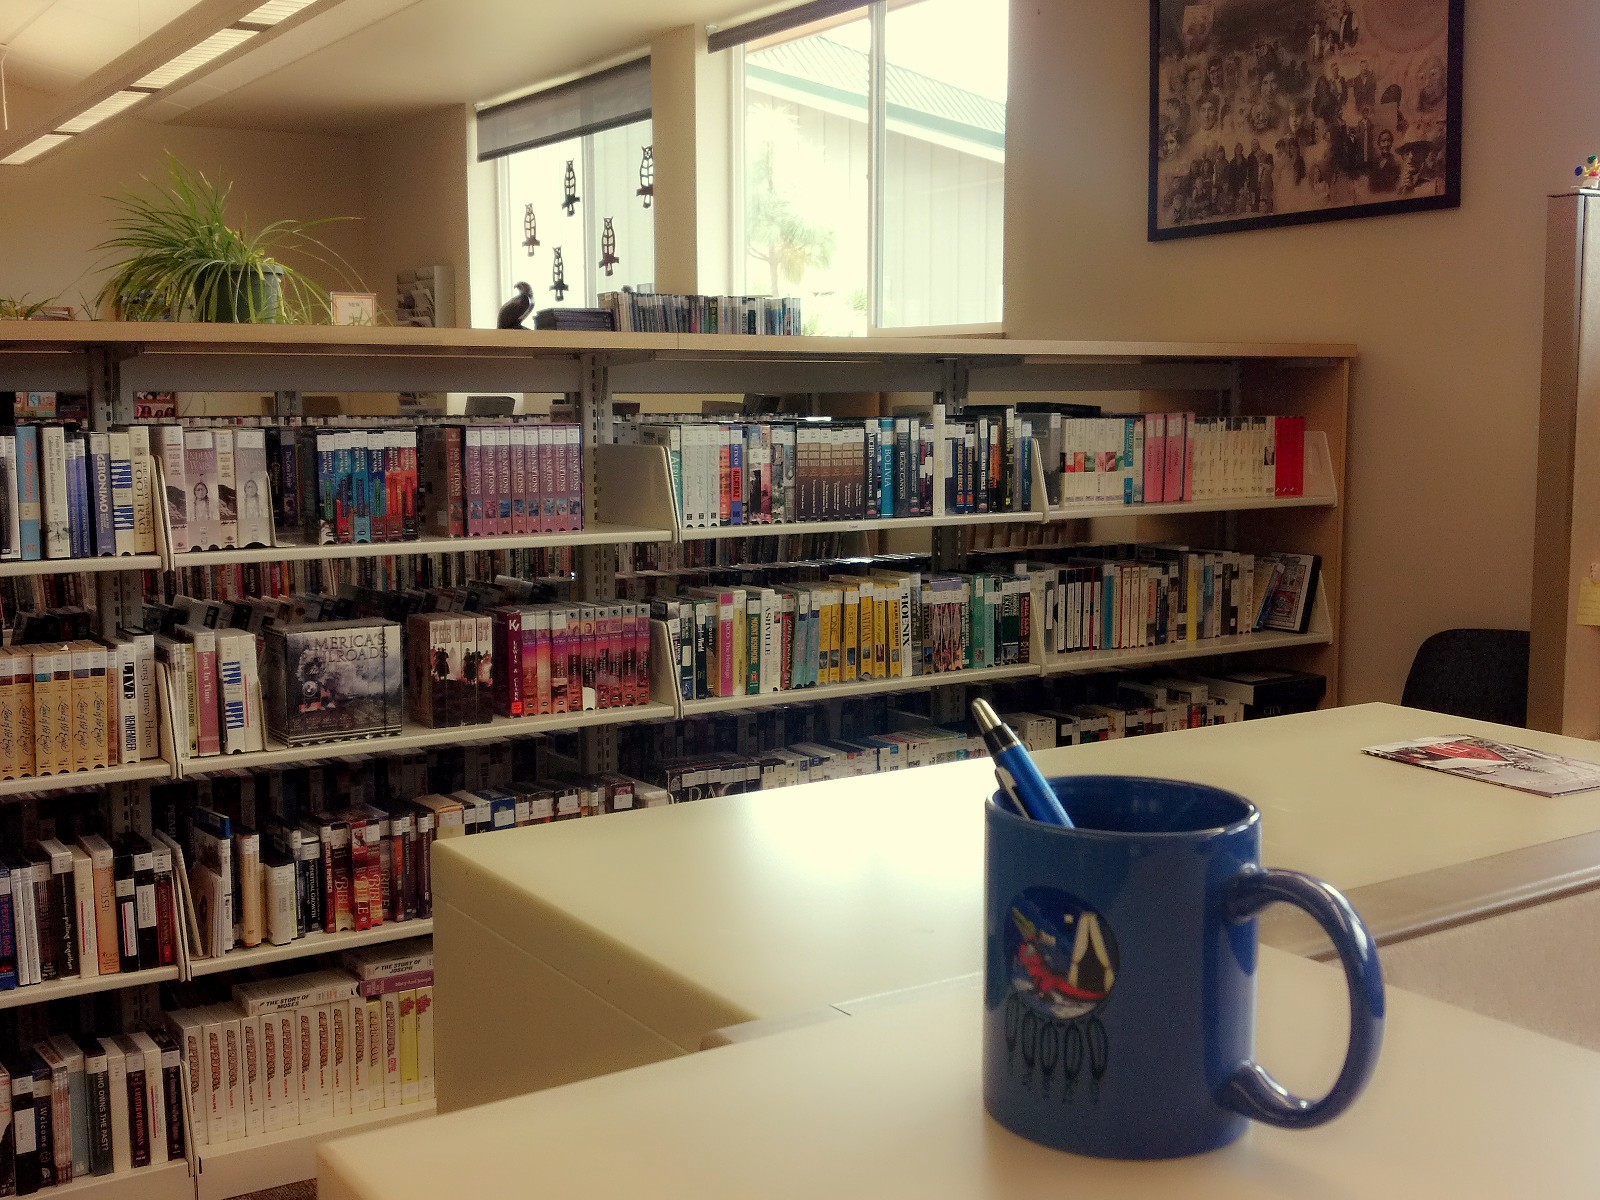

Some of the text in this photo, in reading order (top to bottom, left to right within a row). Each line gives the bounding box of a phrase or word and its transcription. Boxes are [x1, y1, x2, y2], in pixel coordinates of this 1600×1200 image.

[135, 462, 144, 498] FOOT
[884, 449, 892, 487] BOLIVIA
[97, 455, 108, 512] GERONIMO
[862, 611, 871, 643] VATICAN
[901, 593, 910, 646] HOENIX
[123, 662, 135, 699] LIVE
[204, 672, 210, 681] In
[141, 658, 154, 749] Long Journey Home
[125, 715, 137, 751] REMEMBER
[368, 875, 381, 912] BIBLE
[62, 917, 71, 939] pulling
[3, 935, 11, 955] ROAD
[65, 942, 73, 970] together
[389, 966, 414, 974] JOSEPH
[394, 961, 413, 969] STORY
[276, 1001, 300, 1010] MOSES
[280, 996, 300, 1005] STORY
[97, 1072, 105, 1089] WHO
[98, 1090, 106, 1112] OWNS
[40, 1107, 48, 1148] Welcome
[101, 1130, 109, 1151] PAST?
